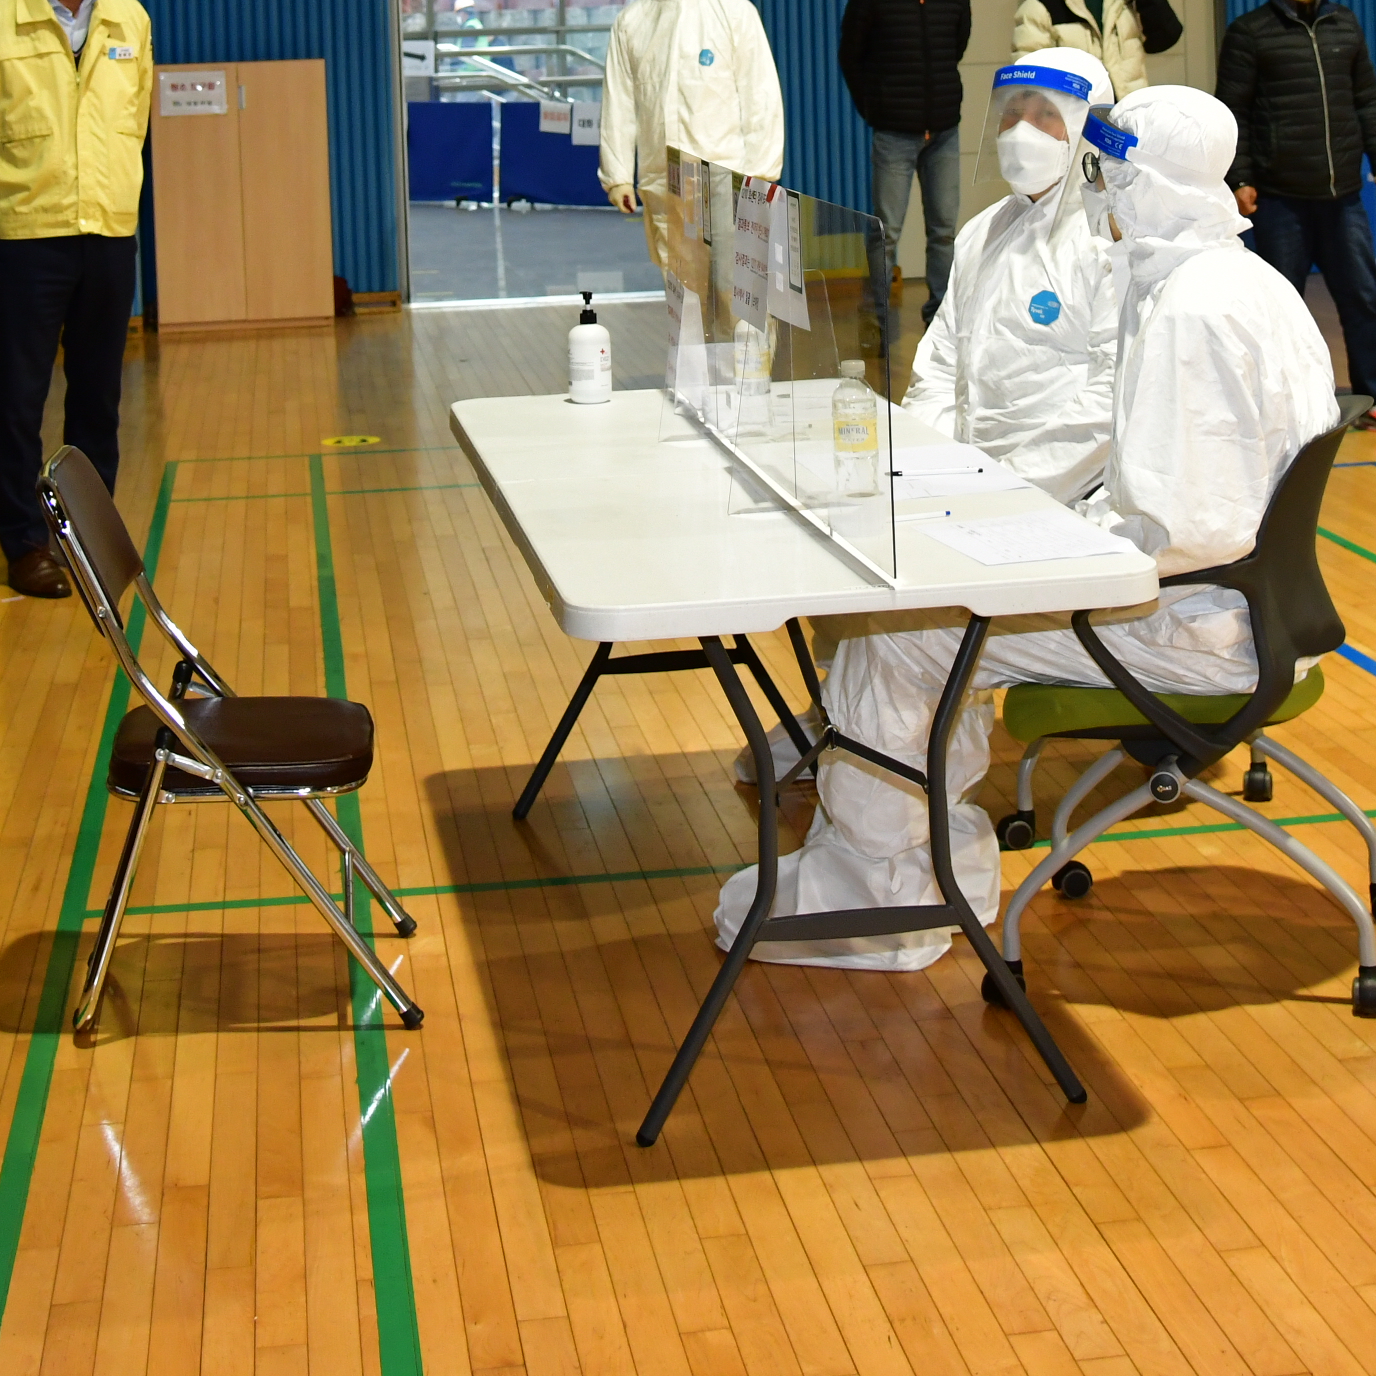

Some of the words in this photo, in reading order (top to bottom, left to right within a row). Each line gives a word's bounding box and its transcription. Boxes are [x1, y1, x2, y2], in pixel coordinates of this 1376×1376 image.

[1000, 72, 1013, 80] Face
[1013, 71, 1036, 79] Shield
[838, 426, 870, 435] MINERAL
